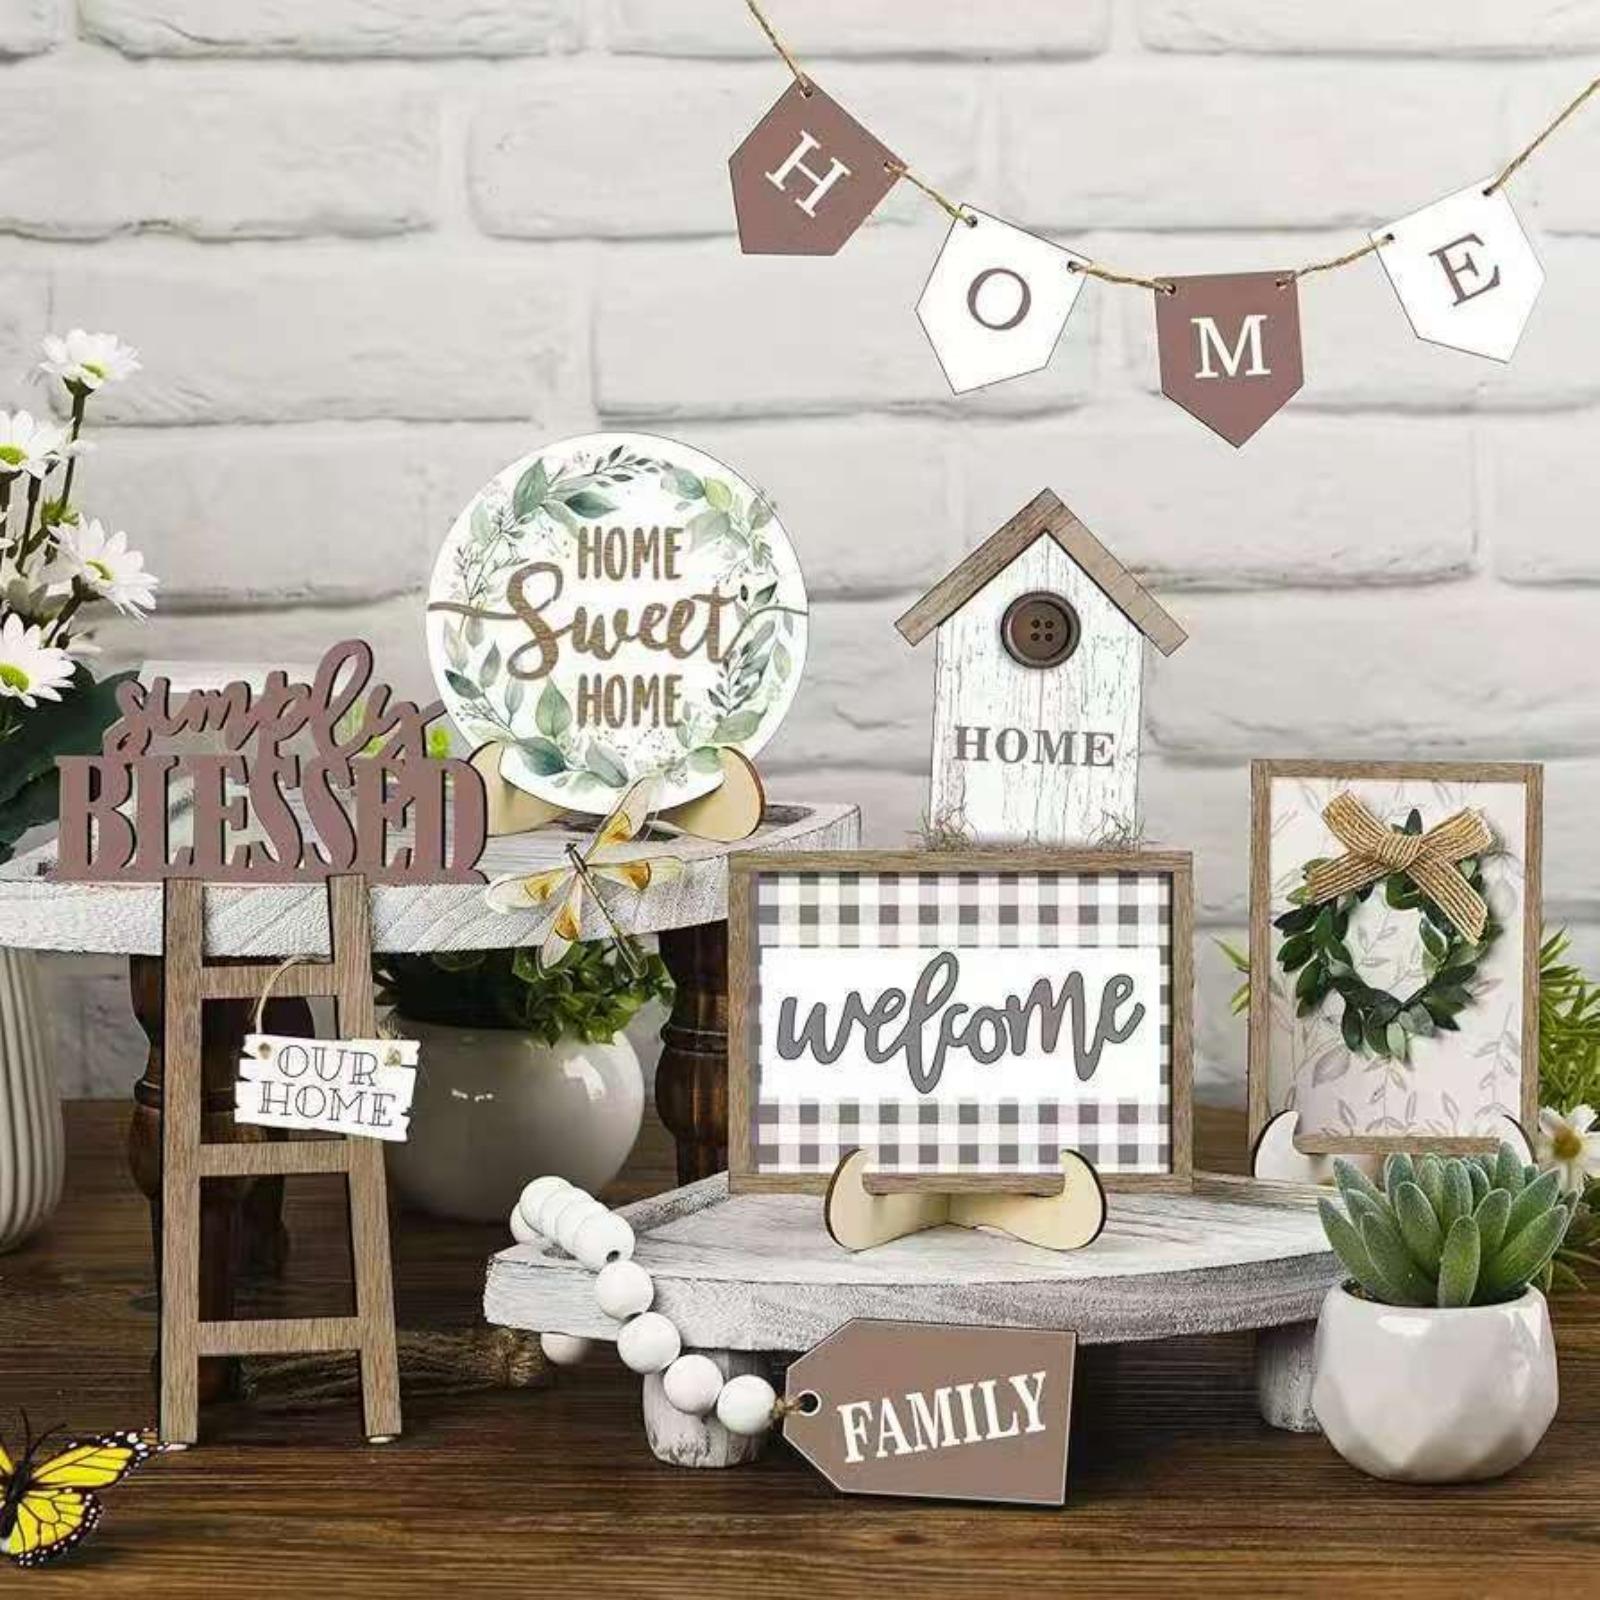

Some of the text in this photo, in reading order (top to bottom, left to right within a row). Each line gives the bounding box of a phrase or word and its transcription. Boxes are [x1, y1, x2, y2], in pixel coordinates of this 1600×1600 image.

[577, 526, 684, 581] HOME
[505, 562, 740, 680] Sweet
[103, 638, 448, 758] simply
[576, 674, 684, 728] HOME
[953, 725, 1114, 767] HOME
[55, 755, 490, 882] BLESSED
[777, 951, 1146, 1094] welcome
[277, 1045, 378, 1087] OUR
[257, 1081, 396, 1127] HOME
[836, 1370, 1047, 1464] FAMILY
